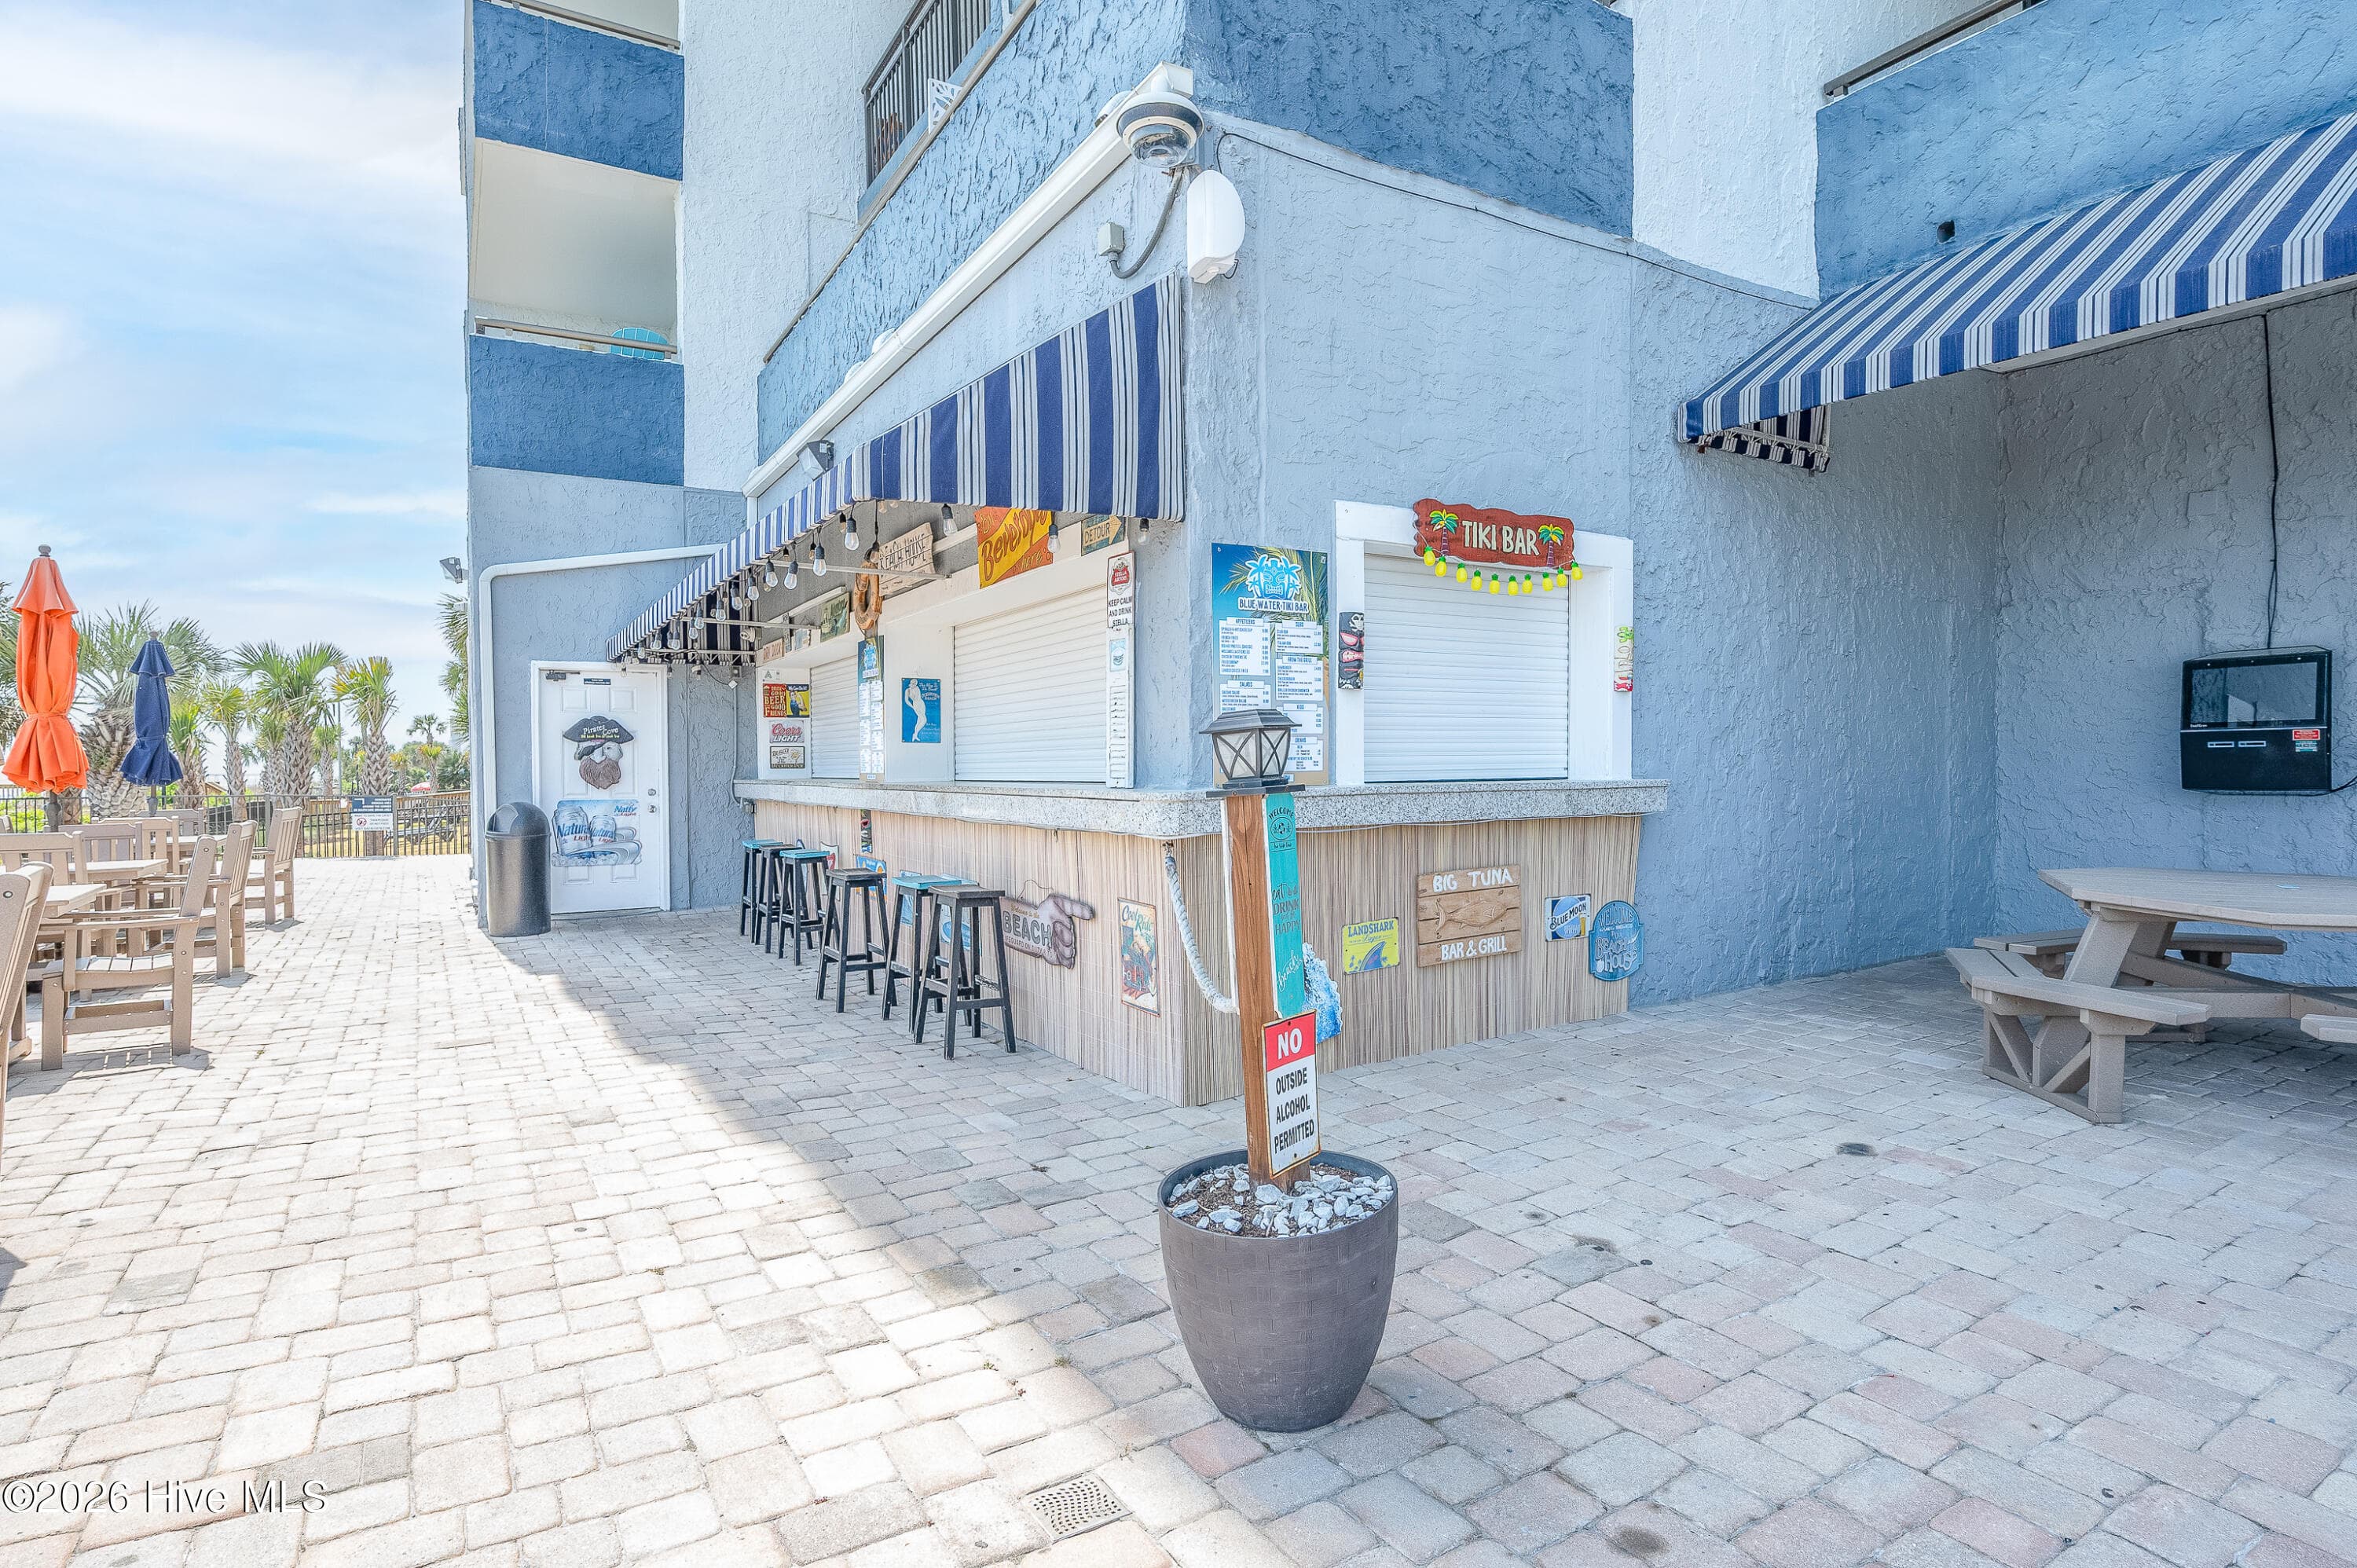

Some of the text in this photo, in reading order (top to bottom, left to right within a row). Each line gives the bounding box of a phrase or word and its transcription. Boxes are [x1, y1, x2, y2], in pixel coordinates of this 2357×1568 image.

[1084, 522, 1110, 544] DETOUR
[1462, 520, 1540, 556] TIKI BAR
[1120, 596, 1132, 605] CALM
[1239, 599, 1307, 611] BLUE WATER TIKI BAR
[1109, 606, 1132, 617] AND DRINK
[1113, 618, 1128, 627] STELLA
[764, 696, 786, 705] BEER
[764, 707, 786, 716] FRIENDS
[583, 724, 606, 735] Pirates
[772, 724, 801, 736] Coors
[1269, 806, 1294, 820] WELCOME
[1432, 868, 1513, 892] BIG TUNA
[1273, 882, 1287, 901] eat
[1273, 898, 1299, 915] DRINK
[1549, 913, 1568, 930] BLUE
[1569, 902, 1587, 919] MOON
[1598, 906, 1634, 927] WELCOME
[1003, 910, 1052, 949] BEACH
[1275, 920, 1300, 936] HAPPY
[1348, 921, 1394, 938] LANDSHARK
[1441, 936, 1507, 961] BAR & GRILL
[1595, 937, 1626, 960] BEACH
[1604, 947, 1637, 973] HOUSE
[1277, 1028, 1303, 1061] NO
[1275, 1067, 1308, 1095] OUTSIDE
[1276, 1094, 1310, 1126] ALCOHOL
[1274, 1119, 1314, 1155] PERMITTED
